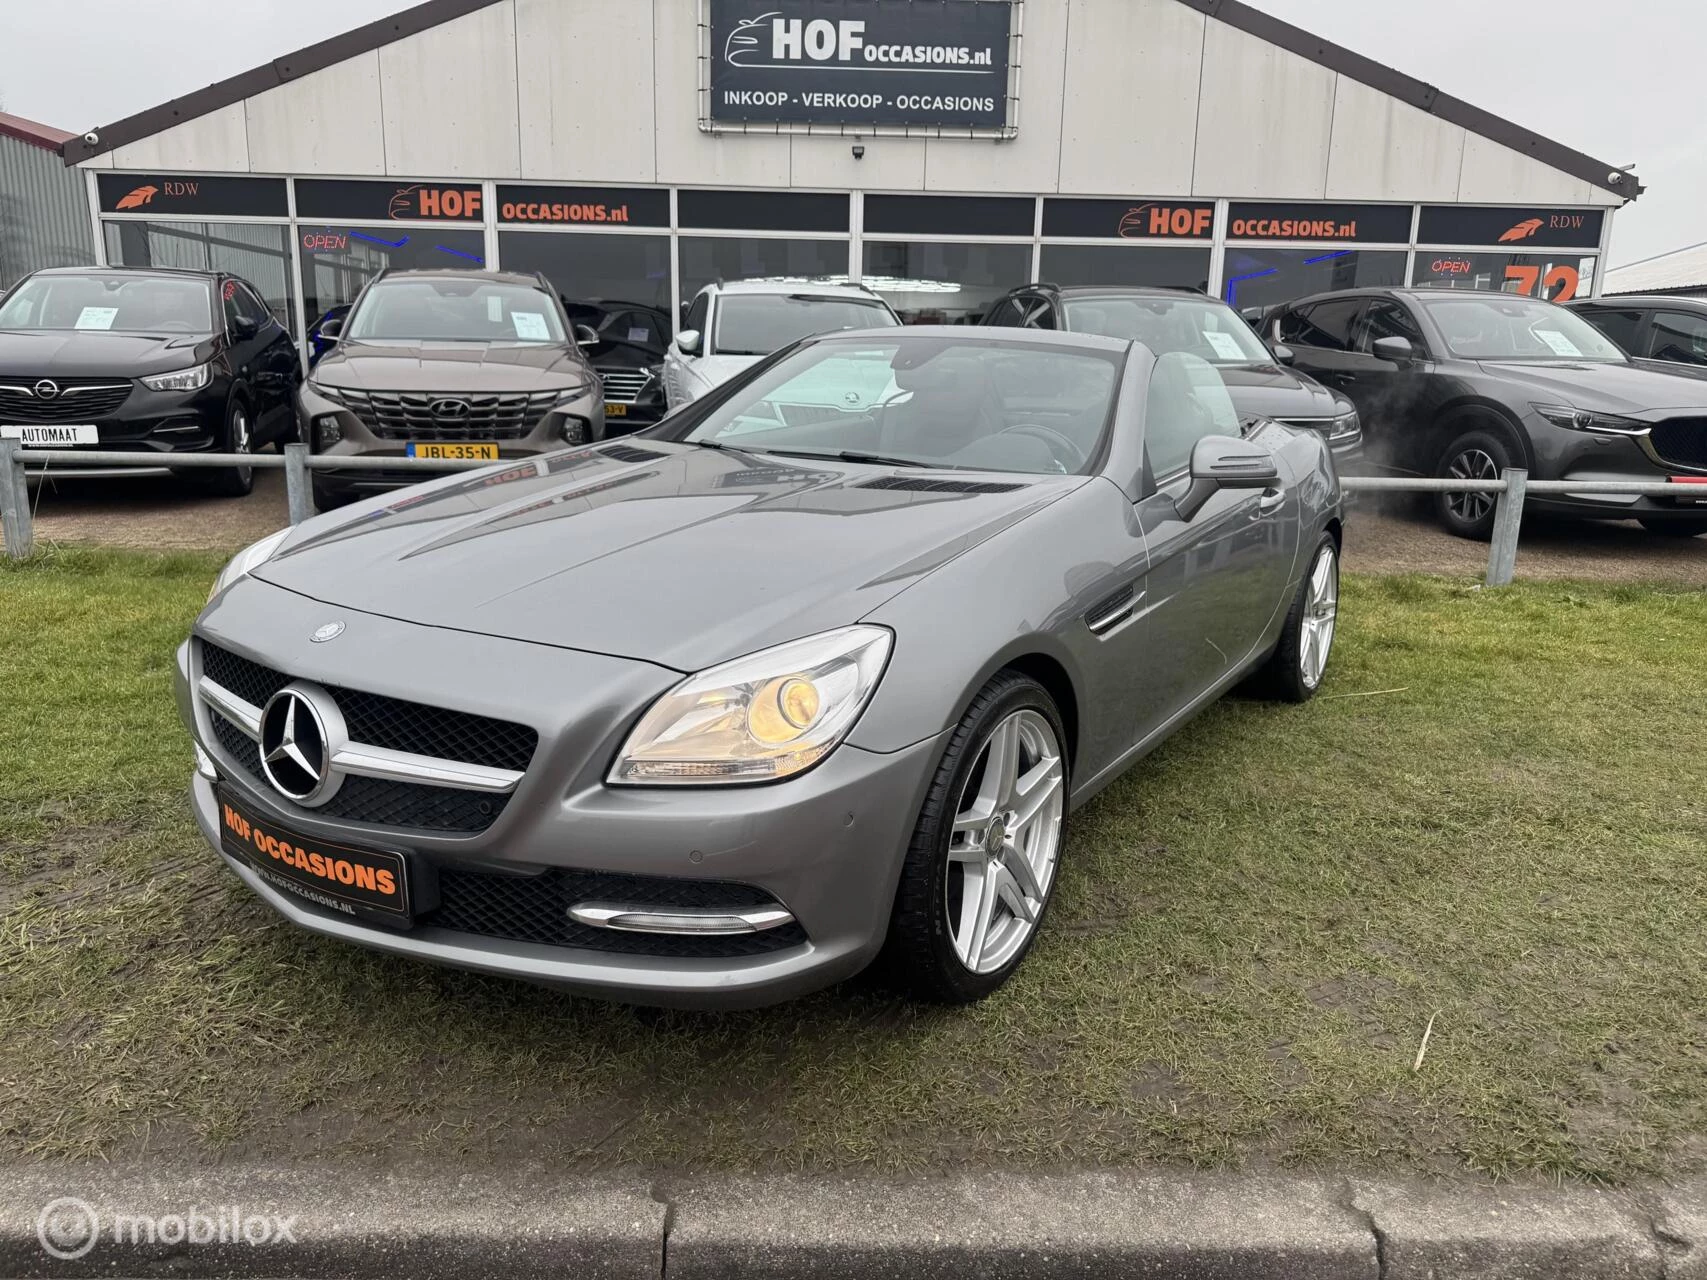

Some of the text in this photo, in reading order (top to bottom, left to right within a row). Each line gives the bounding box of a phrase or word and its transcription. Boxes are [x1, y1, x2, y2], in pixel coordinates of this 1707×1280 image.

[772, 18, 992, 66] HOF OCCASIONS.nl
[723, 90, 789, 106] INKOOP
[801, 92, 883, 109] VERKOOP
[896, 95, 995, 112] OCCASIONS
[163, 181, 200, 196] RDW
[419, 189, 629, 222] HOF OCCASIONS.nl
[1149, 207, 1357, 238] HOF OCCASIONS.nl
[1549, 214, 1585, 229] RDW
[303, 233, 348, 249] OPEN
[1431, 259, 1471, 274] OPEN
[1504, 265, 1580, 304] 72
[21, 427, 78, 442] AUTOMAAT
[422, 446, 491, 460] JBL-35-N
[224, 804, 396, 895] HOF OCCASIONS
